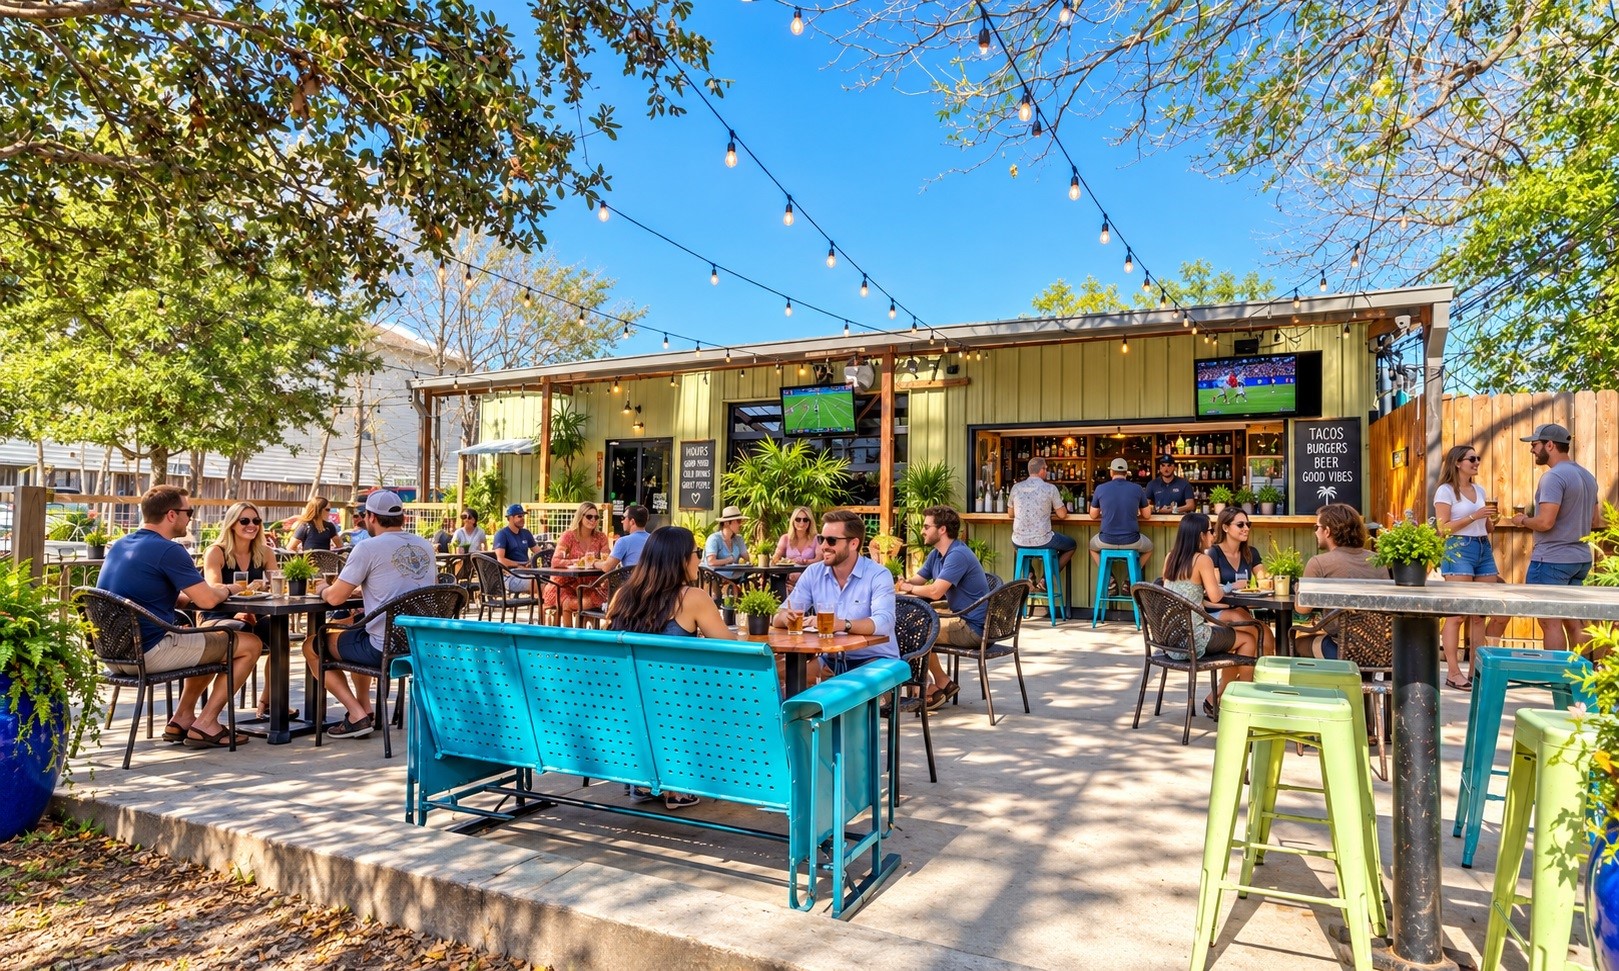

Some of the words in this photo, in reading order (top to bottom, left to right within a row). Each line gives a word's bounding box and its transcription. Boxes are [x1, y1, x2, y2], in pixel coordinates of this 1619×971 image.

[1309, 426, 1344, 440] TACOS
[1306, 442, 1348, 454] BURGERS
[1314, 456, 1339, 469] BEER
[1302, 471, 1326, 482] GOOD
[1328, 470, 1353, 482] VIBES
